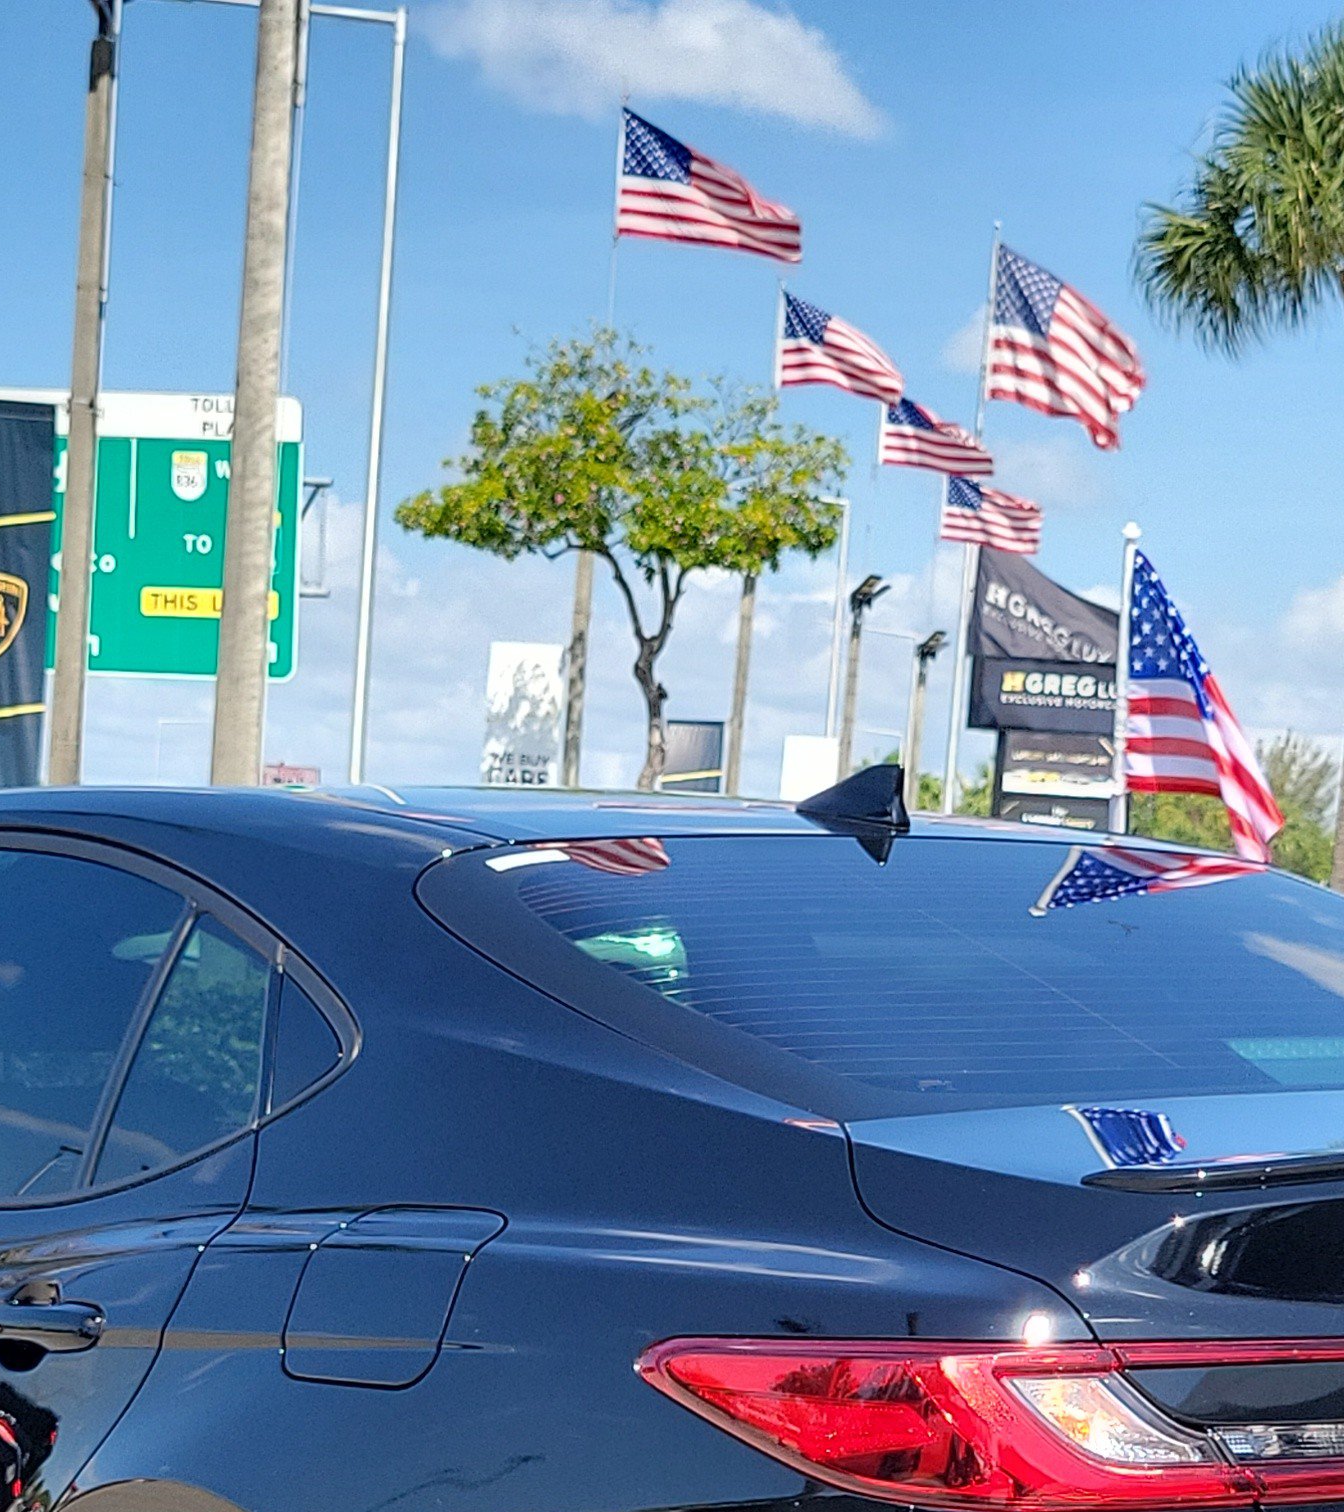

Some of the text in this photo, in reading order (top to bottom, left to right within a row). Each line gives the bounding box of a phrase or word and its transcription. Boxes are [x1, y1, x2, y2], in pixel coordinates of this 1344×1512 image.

[190, 398, 234, 413] TOLL
[183, 533, 213, 555] TO
[150, 593, 198, 611] THIS
